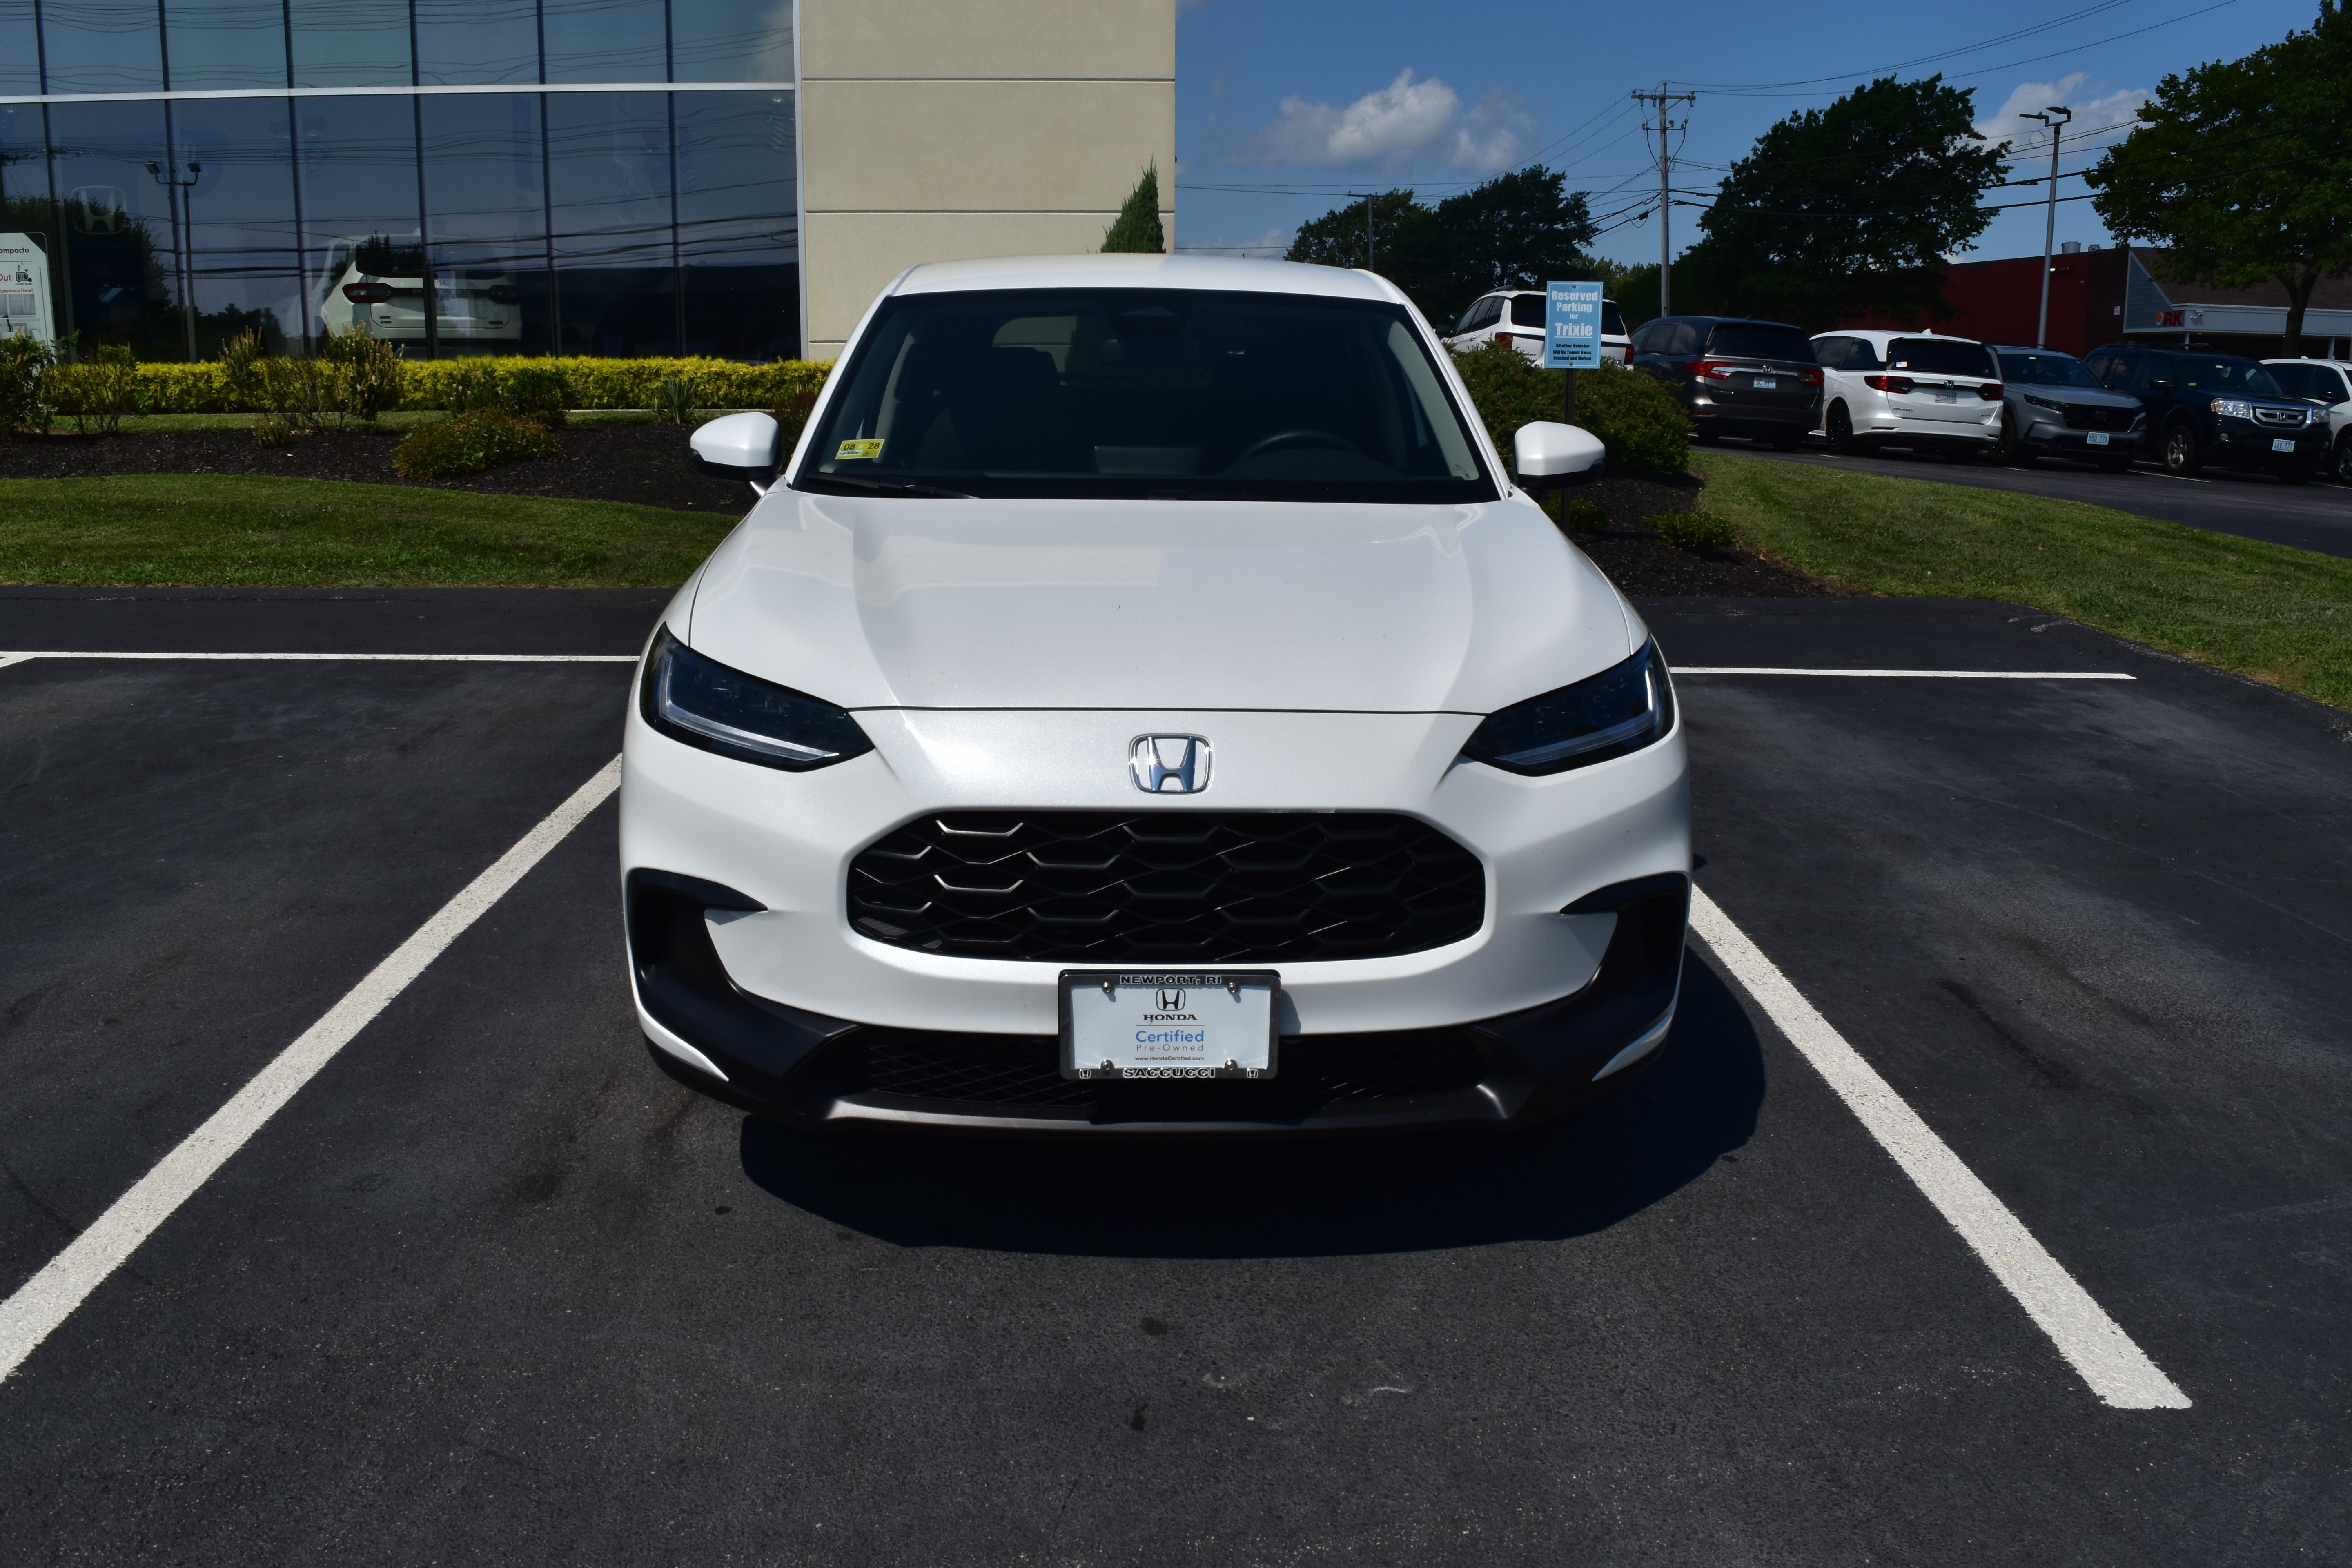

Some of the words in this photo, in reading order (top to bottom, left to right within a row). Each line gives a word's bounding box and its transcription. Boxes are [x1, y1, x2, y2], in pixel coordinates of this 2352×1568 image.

[1551, 290, 1598, 301] Reserved
[1556, 302, 1592, 313] Parking
[1555, 323, 1592, 336] Trixie
[1120, 975, 1200, 985] NEWPORT,
[1205, 975, 1221, 985] RI
[1136, 1030, 1204, 1042] Certified
[1122, 1068, 1216, 1078] SACCUCCI
